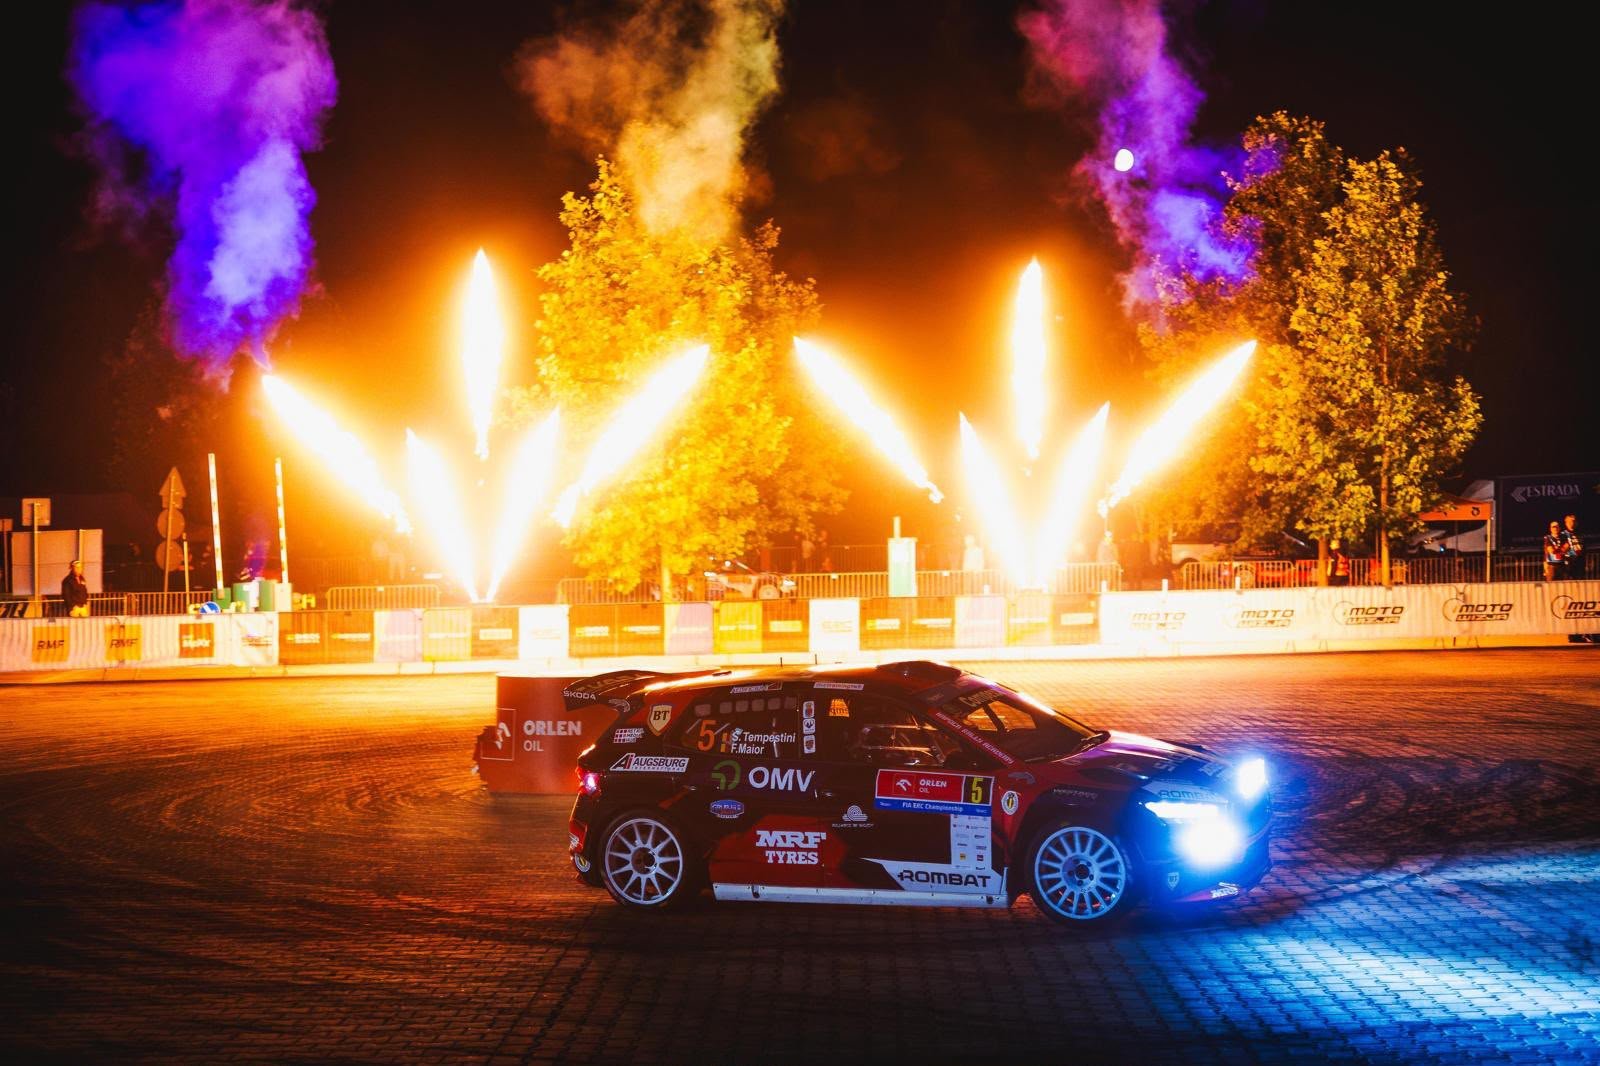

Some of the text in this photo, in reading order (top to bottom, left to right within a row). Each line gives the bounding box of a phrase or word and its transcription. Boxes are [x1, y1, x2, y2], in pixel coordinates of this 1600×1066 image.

[1525, 484, 1581, 498] ESTRADA
[1240, 609, 1295, 619] MOTO
[1349, 606, 1405, 616] MOTO
[1458, 603, 1513, 613] MOTO
[1132, 612, 1187, 622] MOTO
[37, 639, 65, 650] RMF
[652, 710, 670, 721] BT
[522, 719, 583, 736] ORLEN
[697, 719, 717, 752] 5
[731, 731, 797, 743] S. Tempestini
[522, 739, 545, 752] OIL
[730, 742, 765, 755] F.Maior
[632, 757, 686, 767] AUGSBURG
[748, 766, 815, 792] OMV
[918, 778, 948, 788] ORLEN
[971, 777, 983, 804] 5
[912, 802, 924, 810] ERC
[924, 803, 964, 814] Championship
[755, 830, 827, 849] MRF
[765, 850, 819, 865] TYRES
[898, 869, 992, 888] ROMBAT
